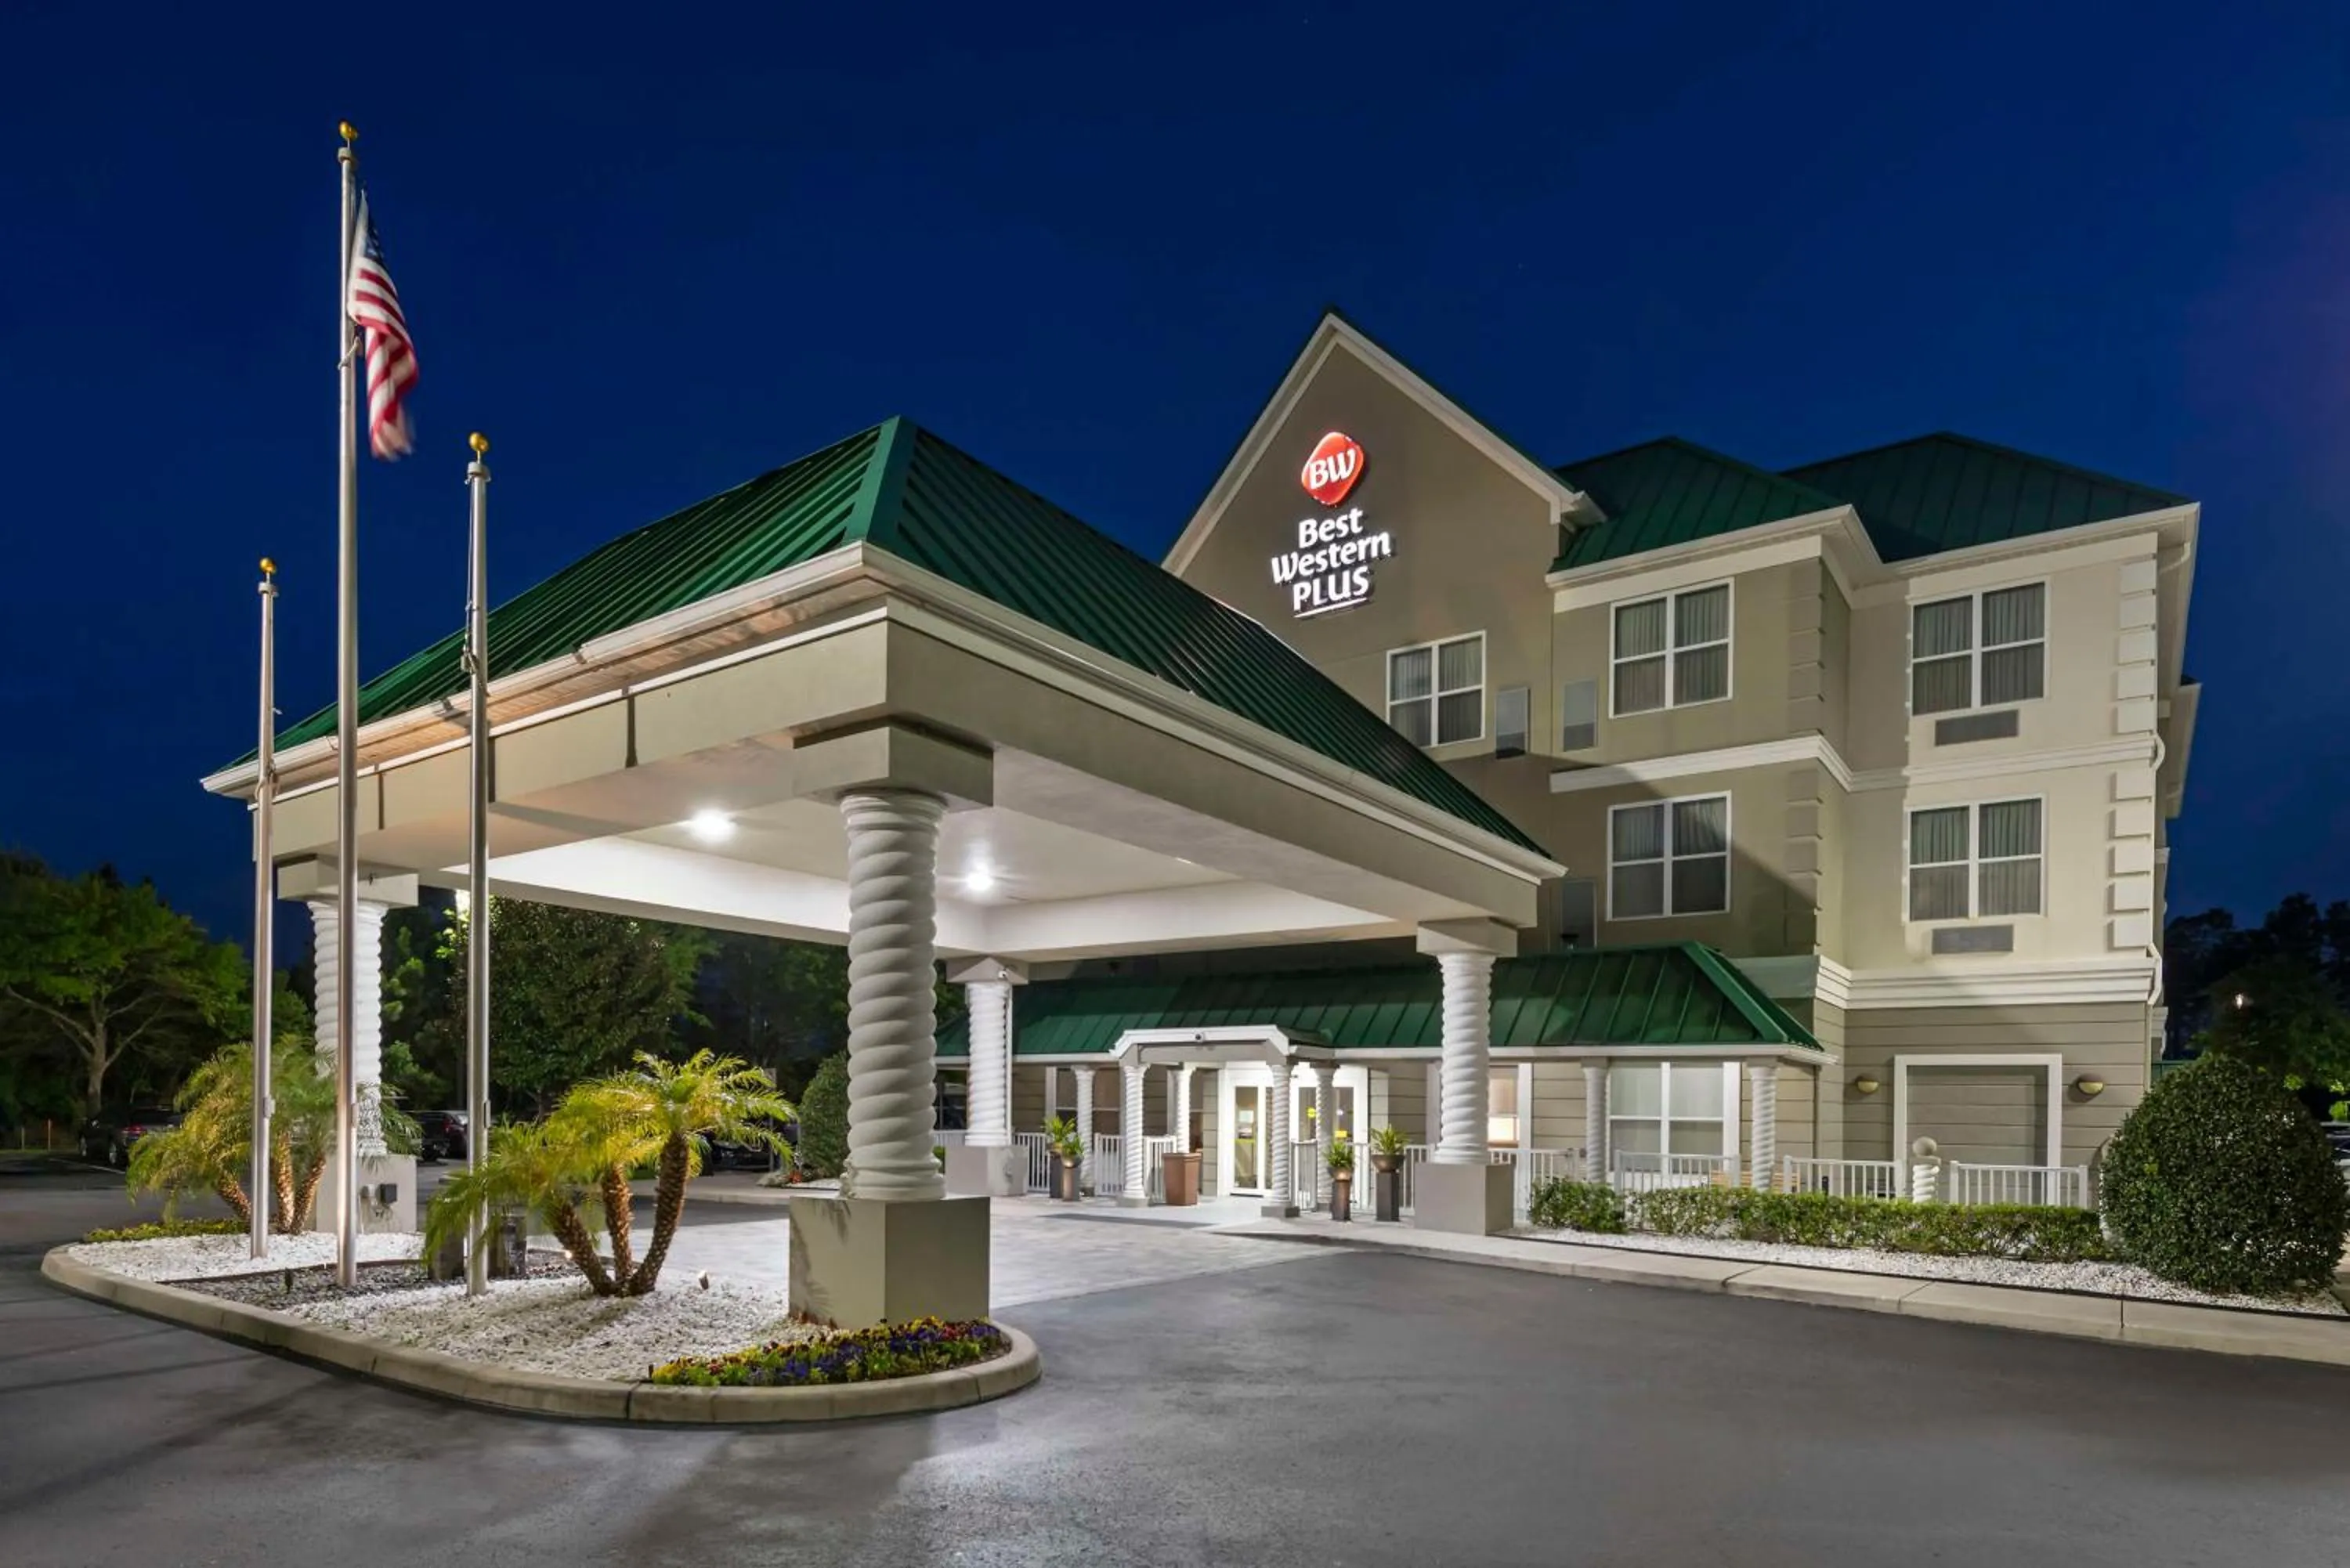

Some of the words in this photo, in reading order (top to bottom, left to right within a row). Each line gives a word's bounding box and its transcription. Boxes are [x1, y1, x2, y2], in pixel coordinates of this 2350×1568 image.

[1309, 449, 1355, 490] BW
[1298, 508, 1364, 548] Best
[1271, 532, 1391, 584] Western
[1292, 565, 1369, 611] PLUS
